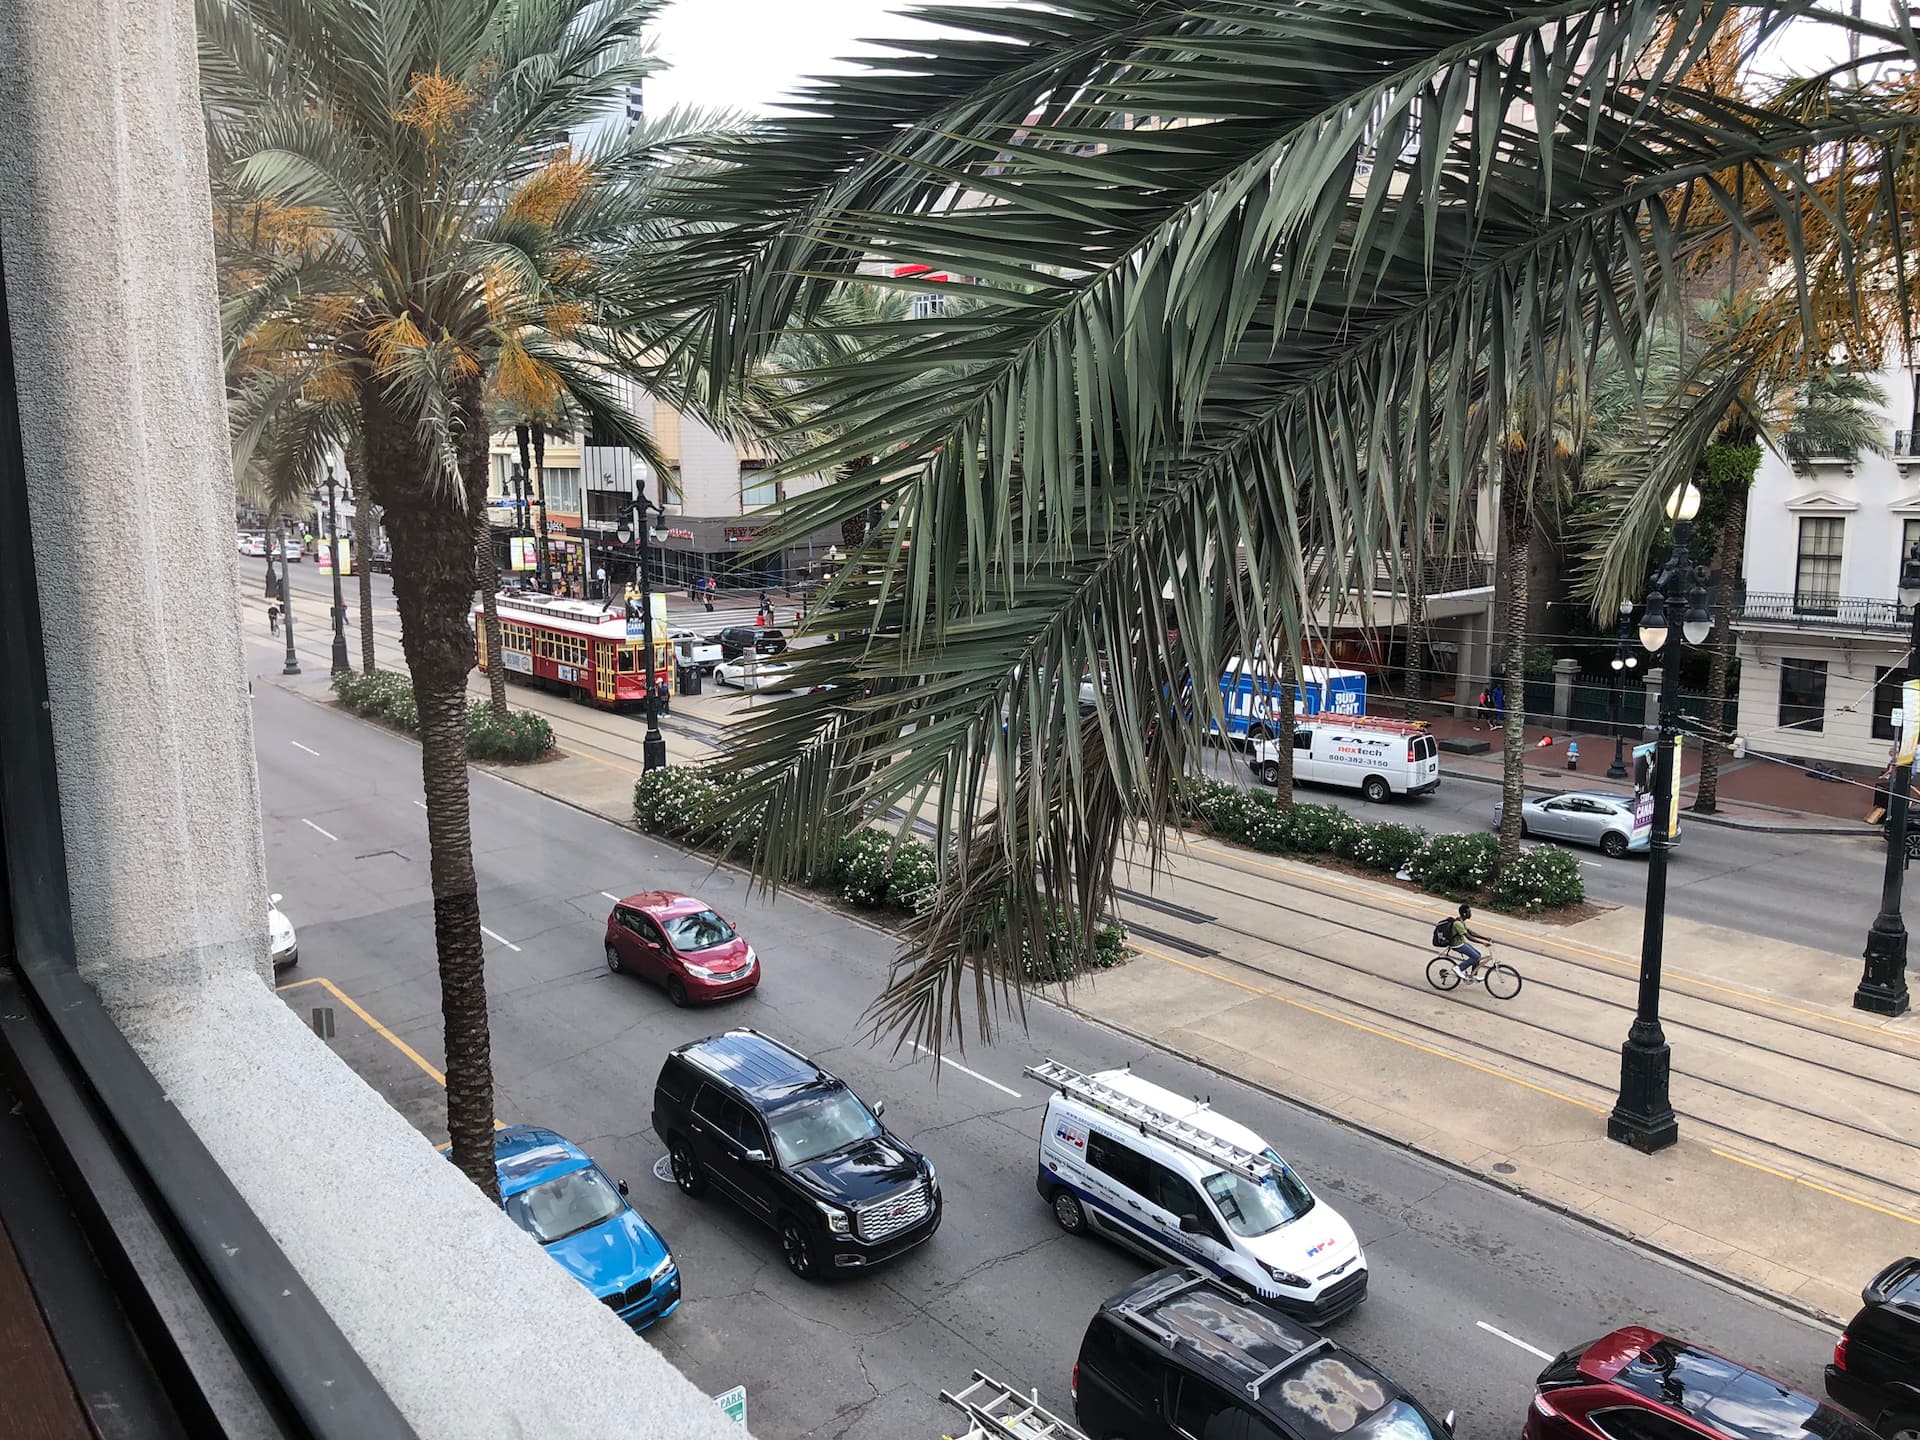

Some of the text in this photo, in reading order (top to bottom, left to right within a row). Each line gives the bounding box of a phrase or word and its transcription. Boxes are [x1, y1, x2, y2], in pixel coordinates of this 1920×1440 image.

[724, 527, 747, 537] FLY
[1335, 691, 1356, 705] BUD
[1330, 702, 1360, 715] LIGHT
[1328, 754, 1389, 767] 800-382-3150
[720, 1391, 744, 1409] PARK
